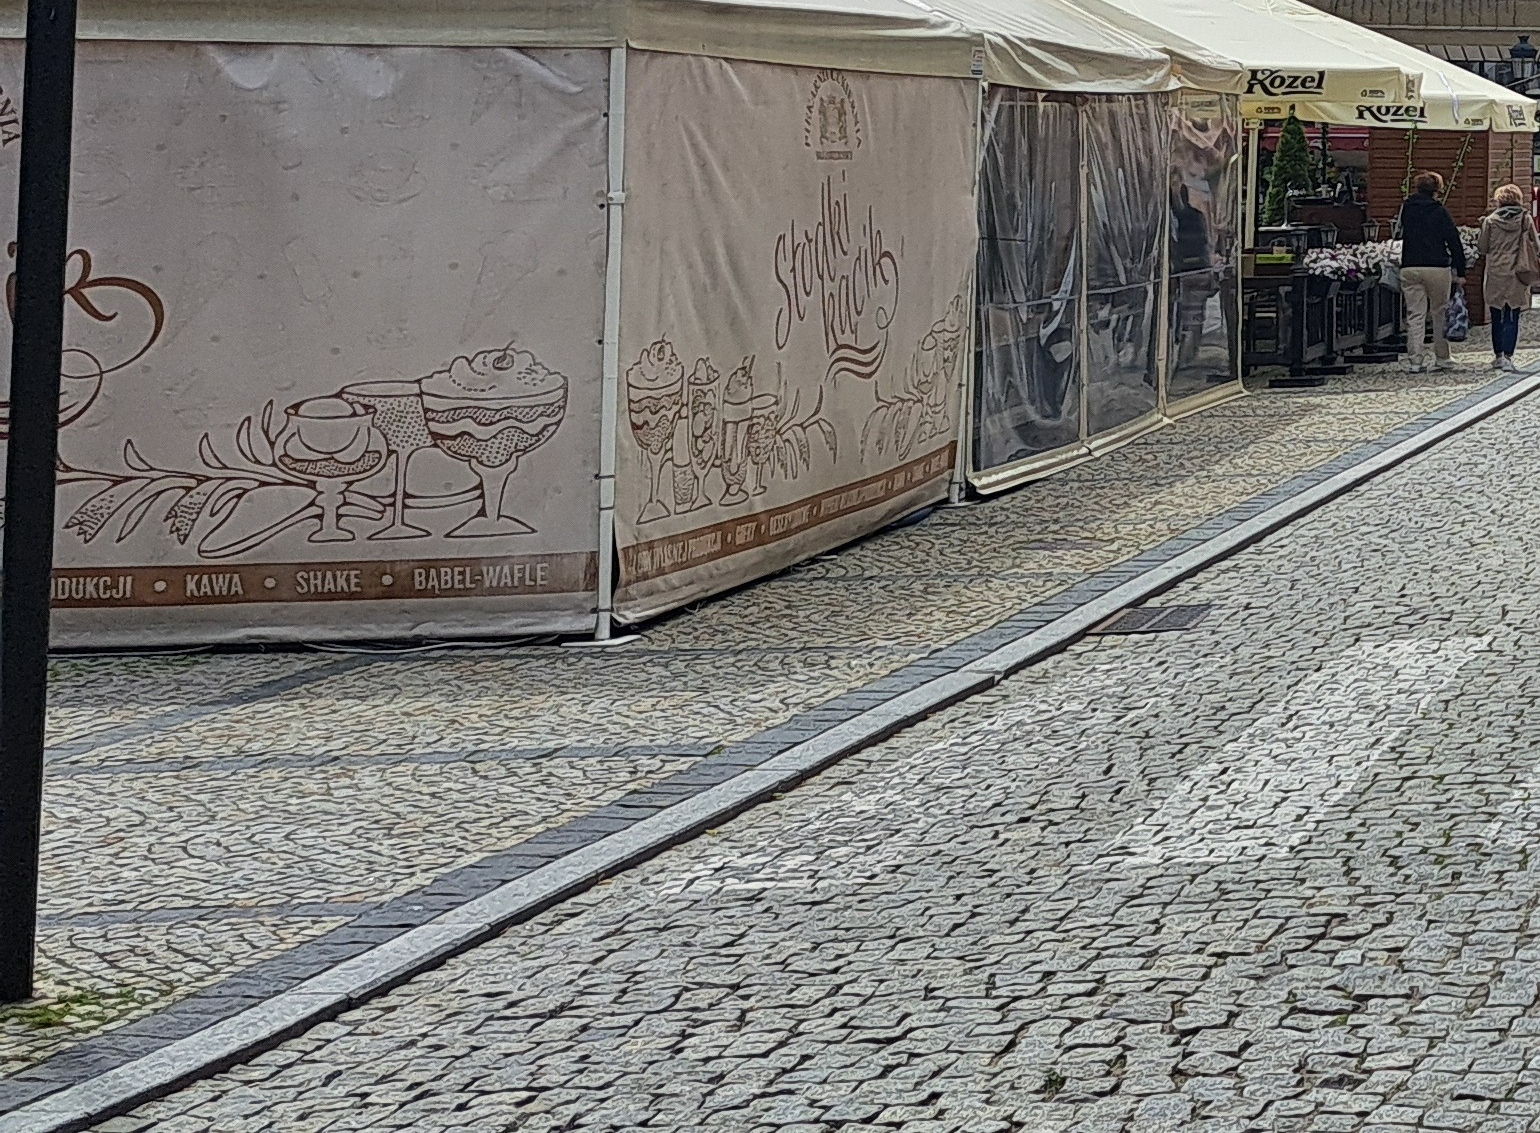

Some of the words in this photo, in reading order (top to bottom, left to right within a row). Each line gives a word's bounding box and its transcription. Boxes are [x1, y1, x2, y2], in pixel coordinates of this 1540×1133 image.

[1243, 68, 1326, 97] Kozel
[1356, 104, 1428, 123] Kozel
[52, 574, 132, 602] DUKCJI
[186, 572, 243, 598] KAWA
[295, 569, 362, 595] SHAKE
[414, 563, 549, 595] BĄBEL-WAFLE
